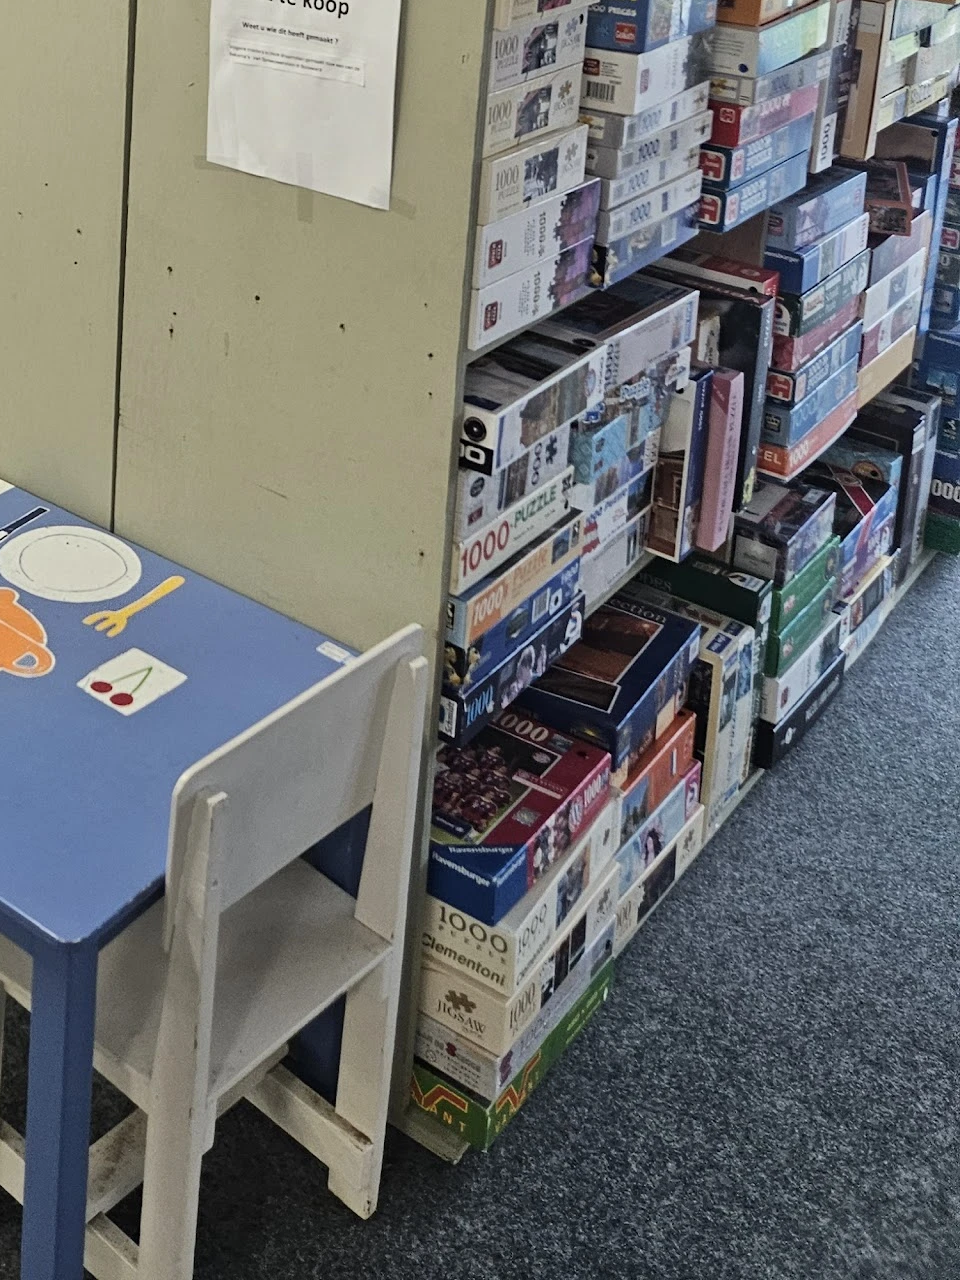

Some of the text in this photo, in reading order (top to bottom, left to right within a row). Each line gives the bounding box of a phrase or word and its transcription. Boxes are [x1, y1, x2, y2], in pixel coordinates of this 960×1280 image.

[607, 6, 637, 17] PIECES
[242, 21, 259, 30] Weet
[266, 25, 277, 33] wie
[278, 27, 287, 35] dit
[287, 29, 305, 39] heeft
[306, 32, 334, 45] gemaakt
[495, 35, 519, 59] 1000
[488, 100, 512, 124] 1000
[638, 138, 660, 163] 1000
[495, 164, 520, 191] 1000
[628, 169, 649, 189] 1000
[630, 201, 651, 222] 1000
[539, 211, 547, 246] 1000
[533, 271, 541, 304] 1000
[461, 485, 557, 577] 1000 PUZZLE
[444, 702, 455, 735] Schmidt
[465, 685, 494, 728] 1000
[448, 845, 514, 854] Ravensburger
[432, 851, 490, 887] Ravensburger
[439, 903, 548, 955] 1000 1000
[439, 925, 508, 965] PUZZLE
[421, 933, 505, 986] Clementoni
[438, 982, 536, 1035] JIGSAW 1000
